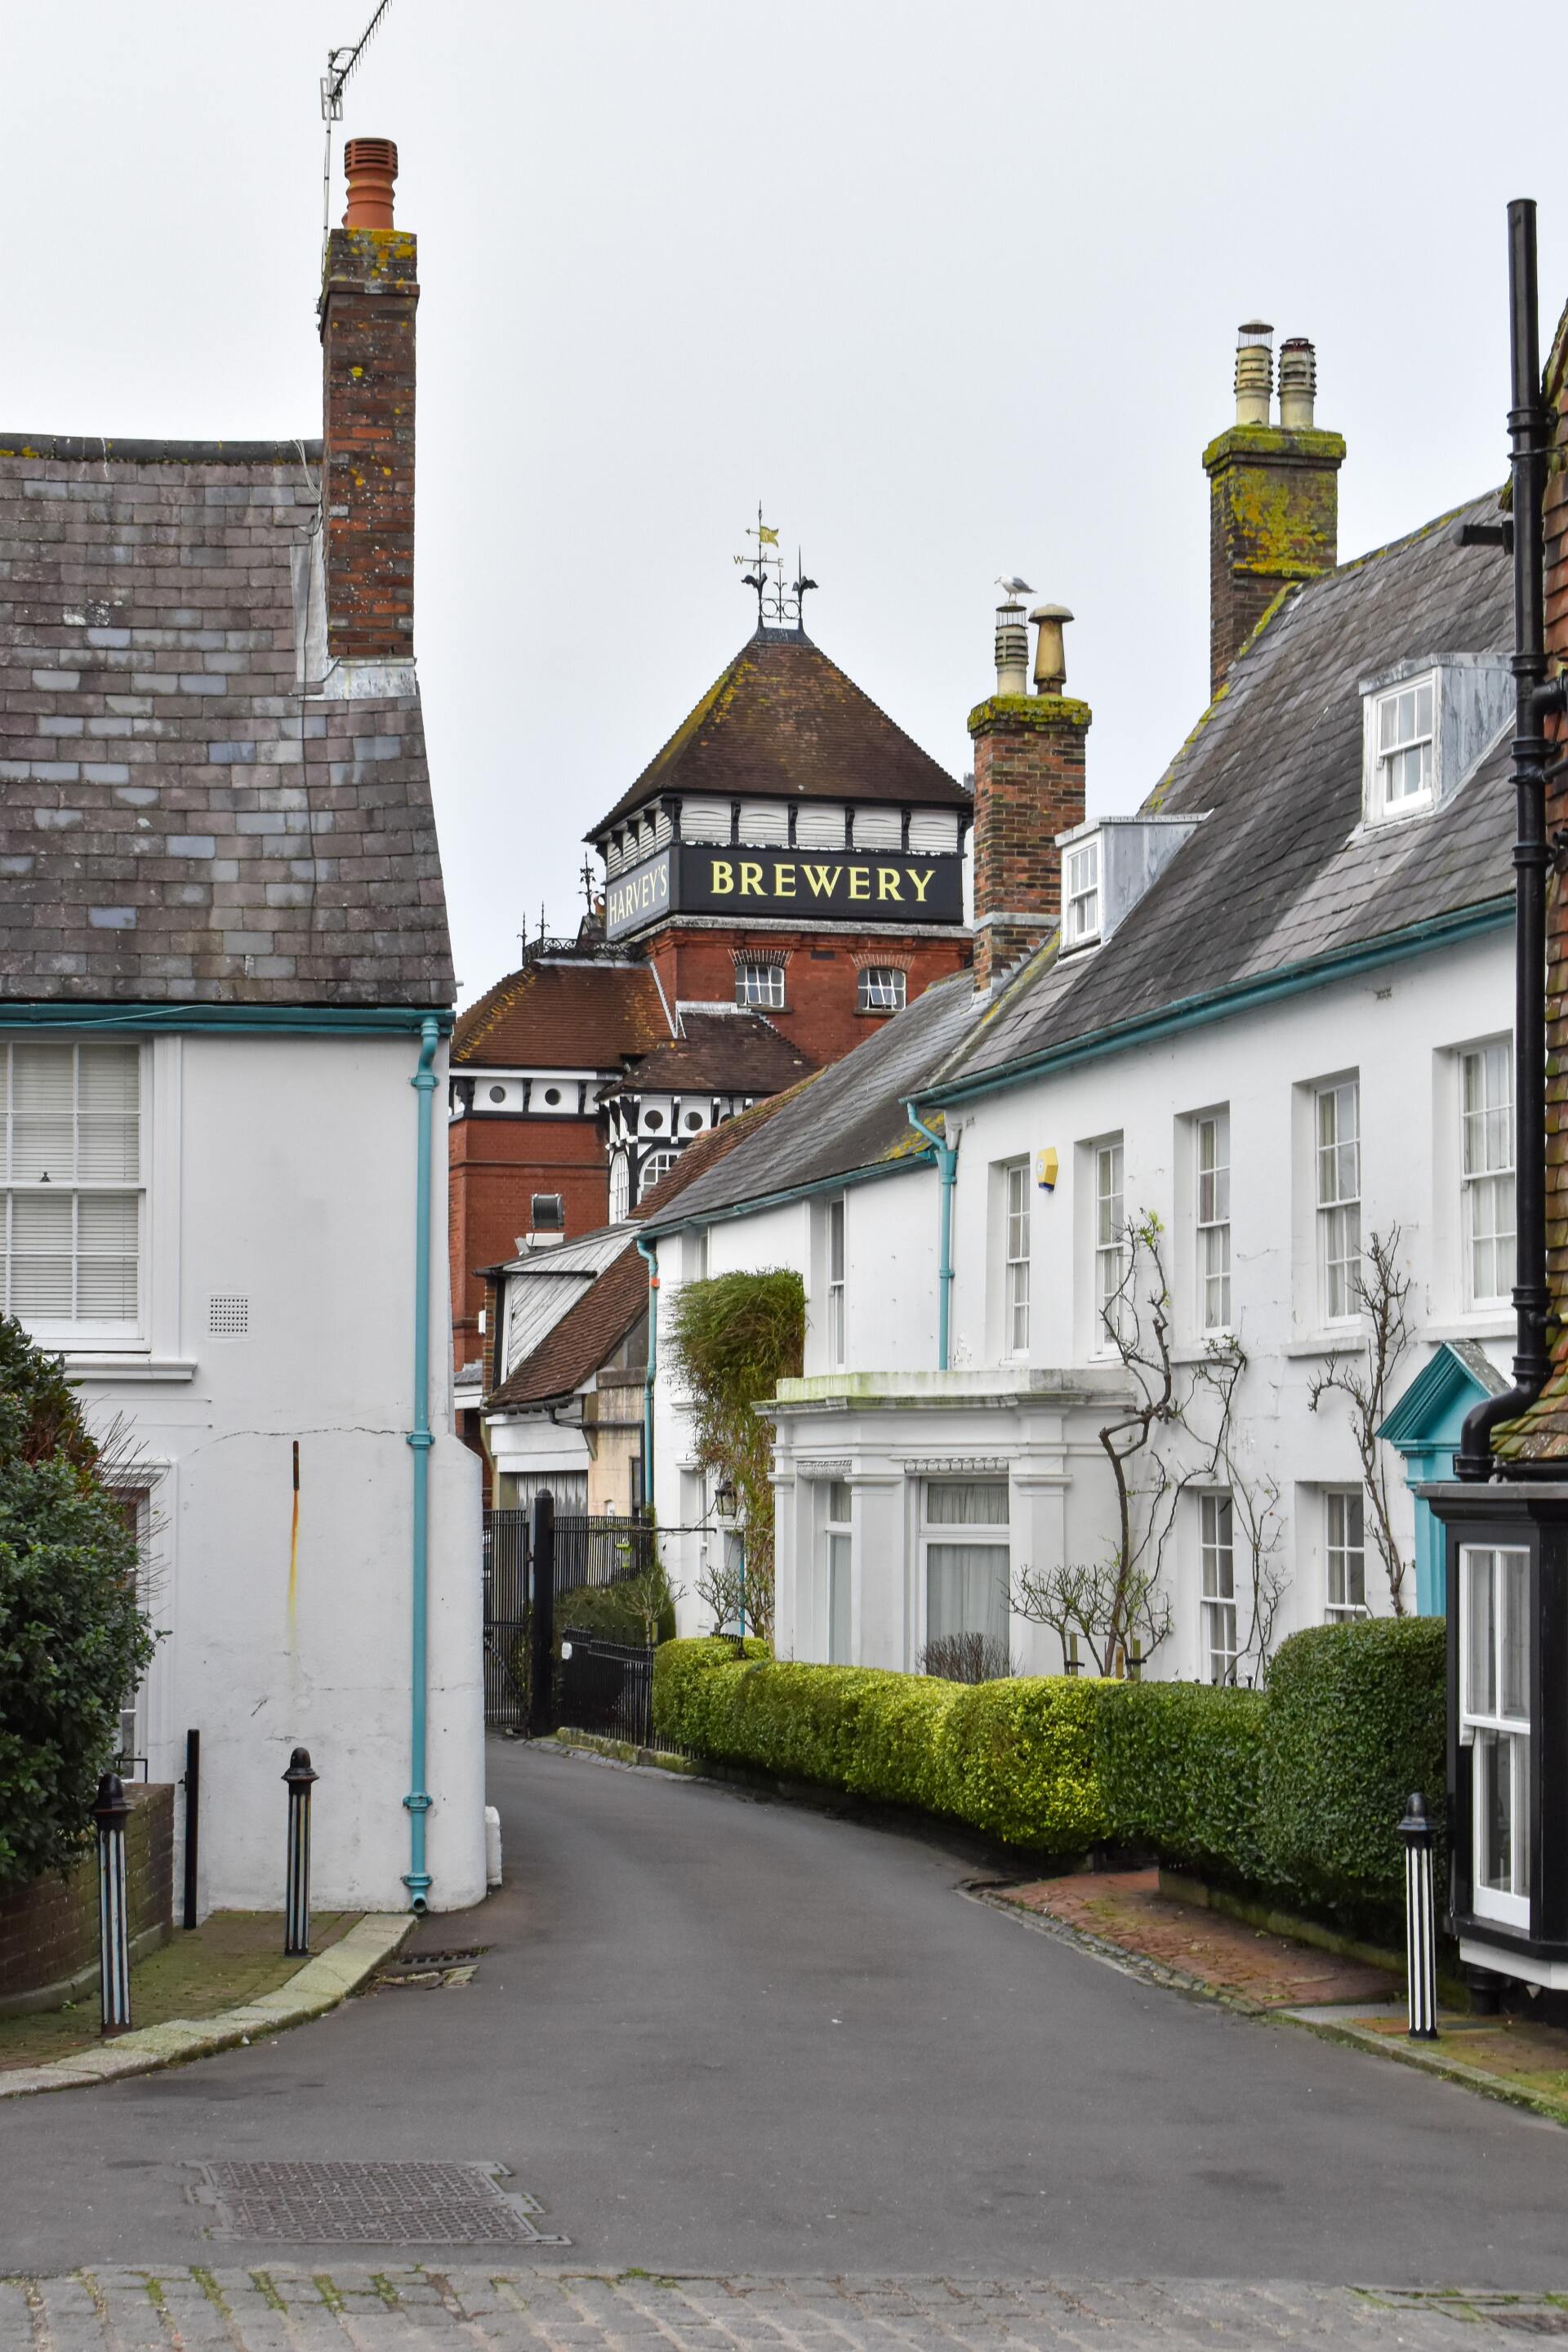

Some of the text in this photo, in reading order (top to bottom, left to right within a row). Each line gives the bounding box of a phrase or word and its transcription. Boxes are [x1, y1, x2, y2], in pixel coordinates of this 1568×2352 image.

[733, 555, 743, 565] W
[778, 559, 784, 567] E
[609, 861, 937, 927] HARVEY'S BREWERY
